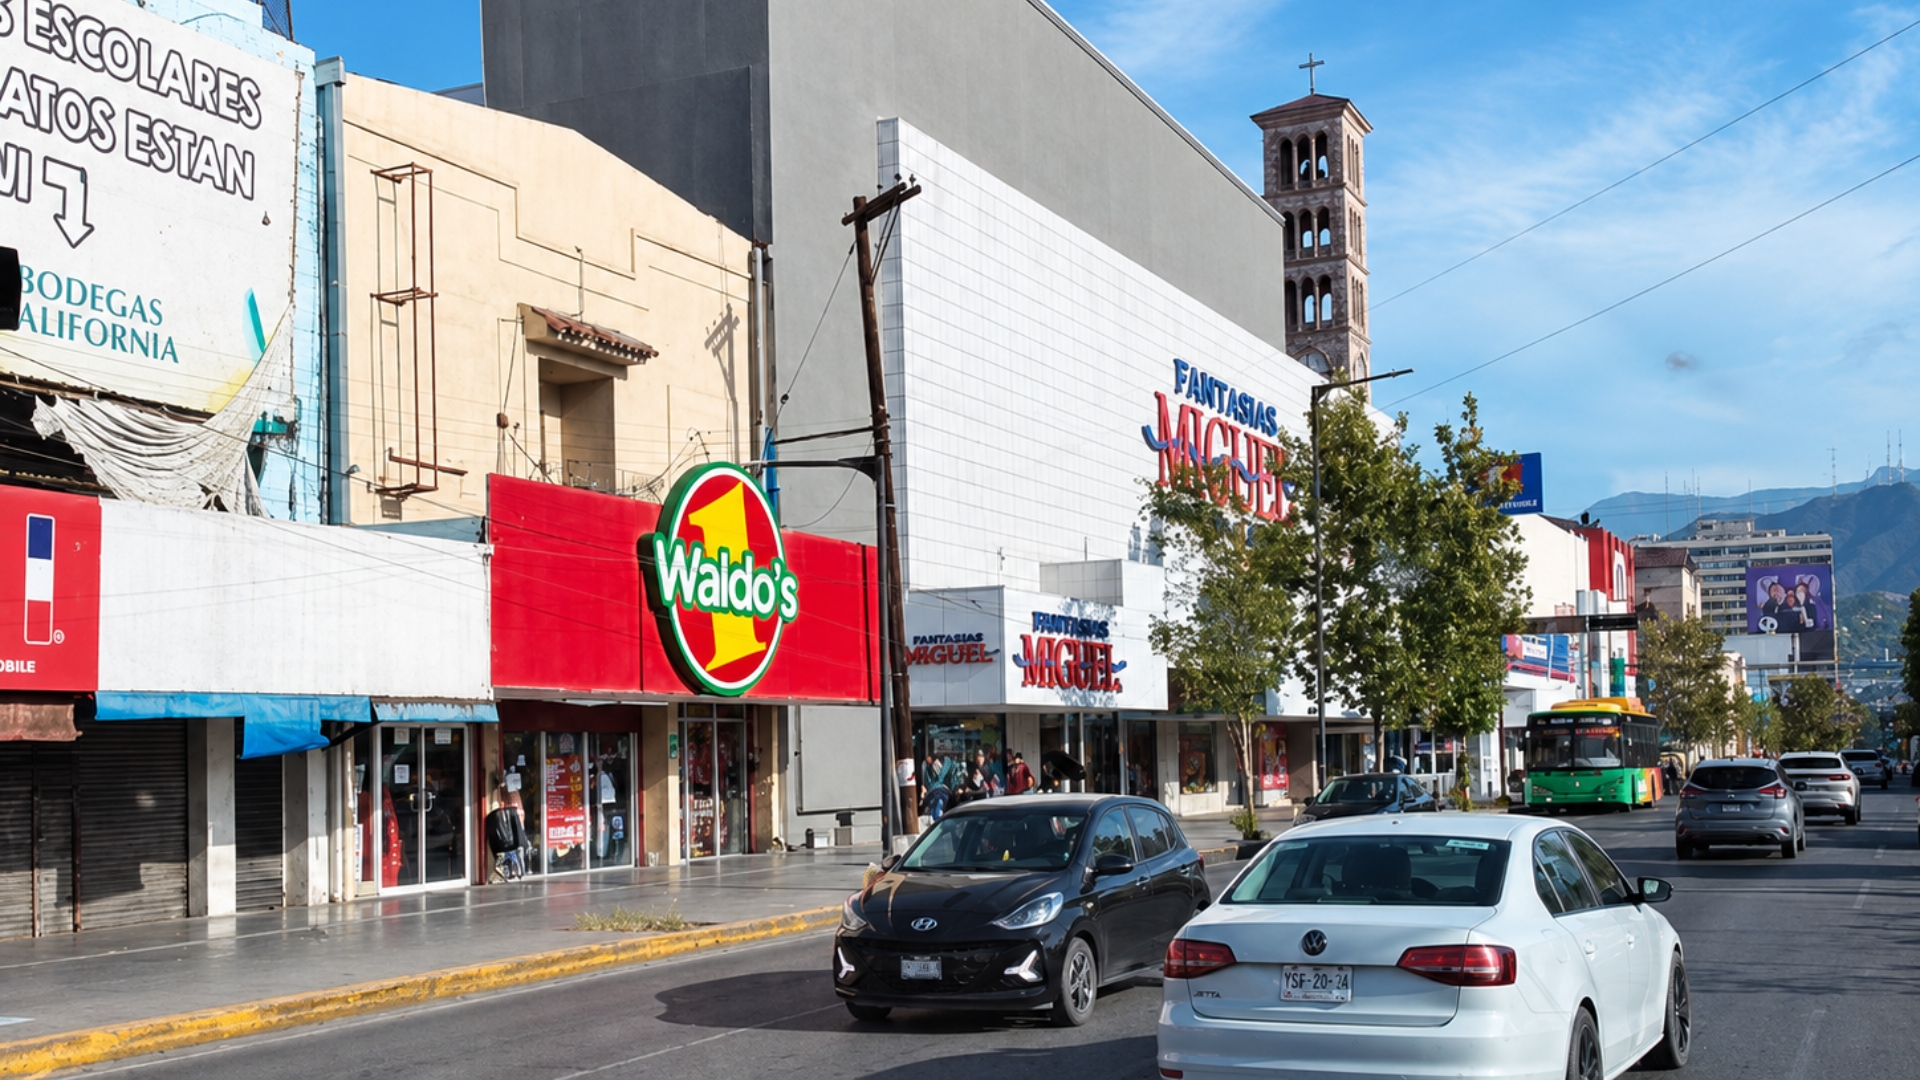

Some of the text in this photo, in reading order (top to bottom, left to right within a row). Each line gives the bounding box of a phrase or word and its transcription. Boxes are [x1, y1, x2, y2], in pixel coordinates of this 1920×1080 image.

[24, 0, 261, 129] ESCOLARES
[125, 107, 255, 200] ESTAN
[20, 264, 163, 326] BODEGAS
[19, 302, 179, 364] ALIFORNIA
[1173, 358, 1278, 437] FANTASIAS
[655, 539, 798, 618] Waldo's
[906, 643, 994, 666] MIGUEL
[913, 633, 984, 645] FANTASIAS
[1032, 611, 1110, 638] FANTASIAS
[1020, 634, 1123, 693] MIGUEL
